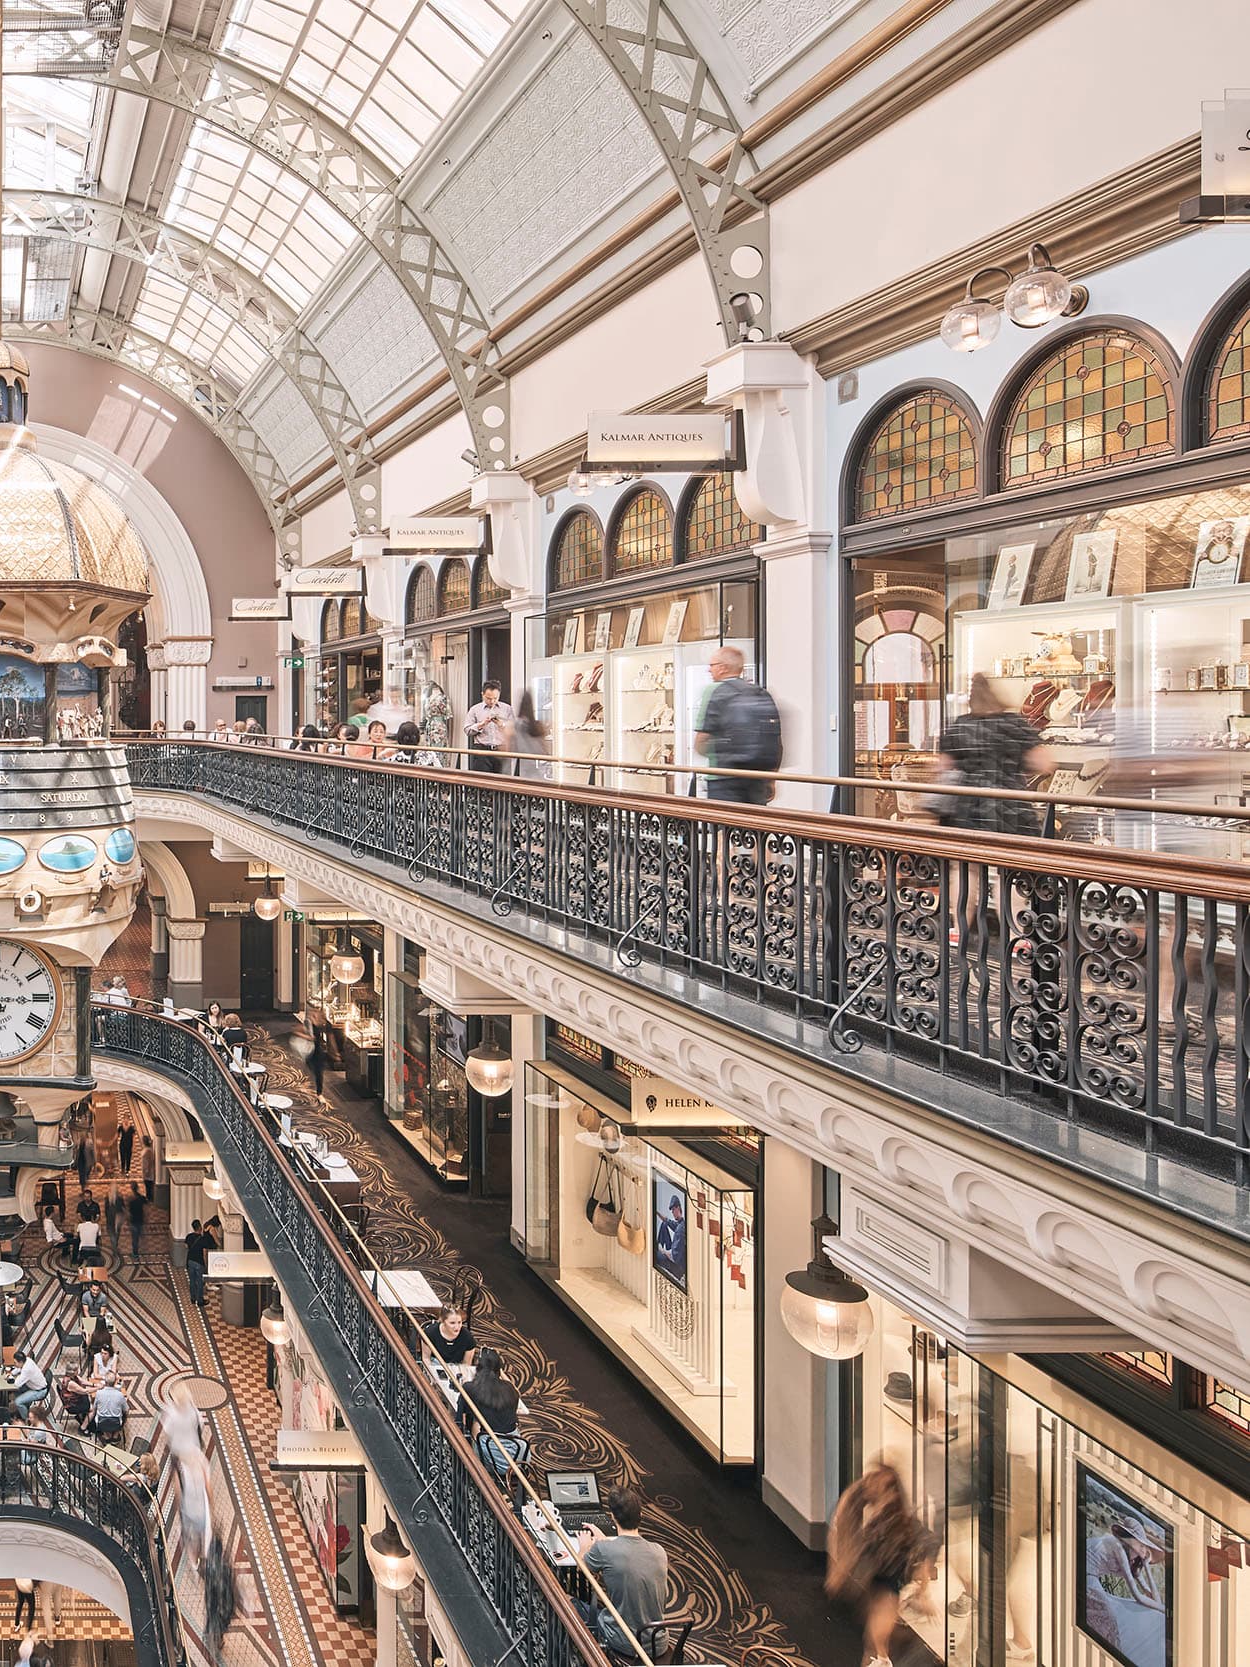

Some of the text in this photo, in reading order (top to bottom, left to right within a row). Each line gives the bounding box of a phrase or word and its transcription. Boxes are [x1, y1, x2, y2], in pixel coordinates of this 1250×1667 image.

[40, 792, 88, 803] SATURDAY
[9, 814, 15, 824] 7
[39, 813, 46, 824] 8
[68, 813, 74, 822] 9
[12, 951, 22, 966] I
[26, 968, 42, 982] II
[32, 994, 50, 1002] III
[665, 1098, 700, 1108] HELEN
